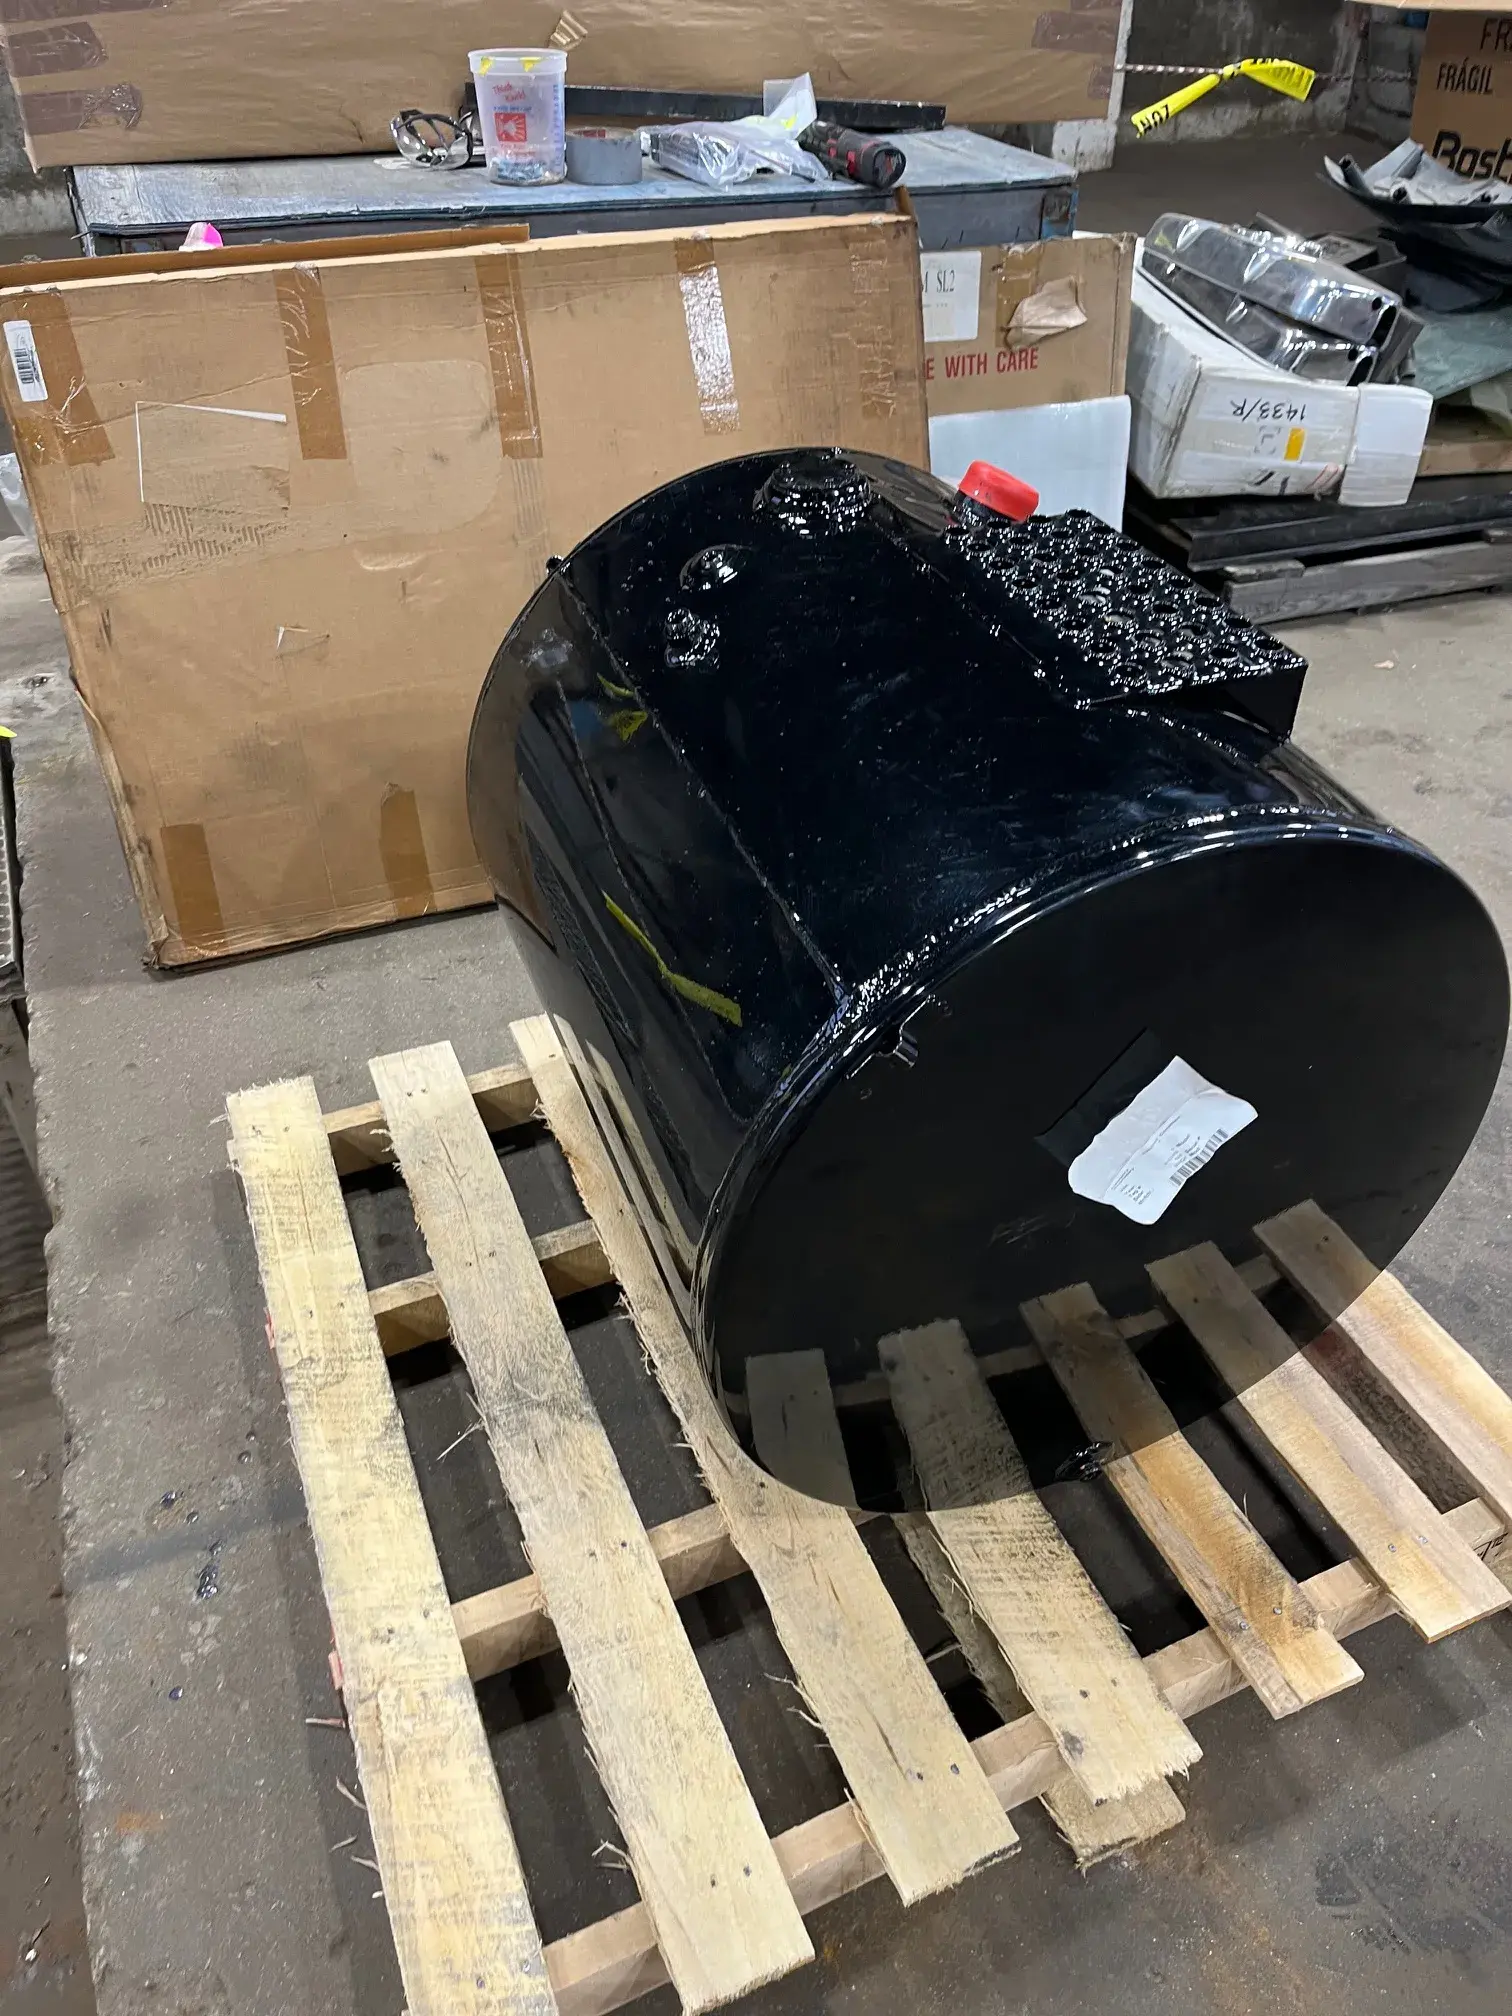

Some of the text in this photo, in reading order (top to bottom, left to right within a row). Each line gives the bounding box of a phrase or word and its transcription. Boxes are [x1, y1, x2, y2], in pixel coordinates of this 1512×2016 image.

[1480, 17, 1512, 51] FR
[1436, 56, 1494, 95] FRÁGIL
[924, 345, 1040, 380] E WITH CARE
[1229, 397, 1307, 422] 1433/R
